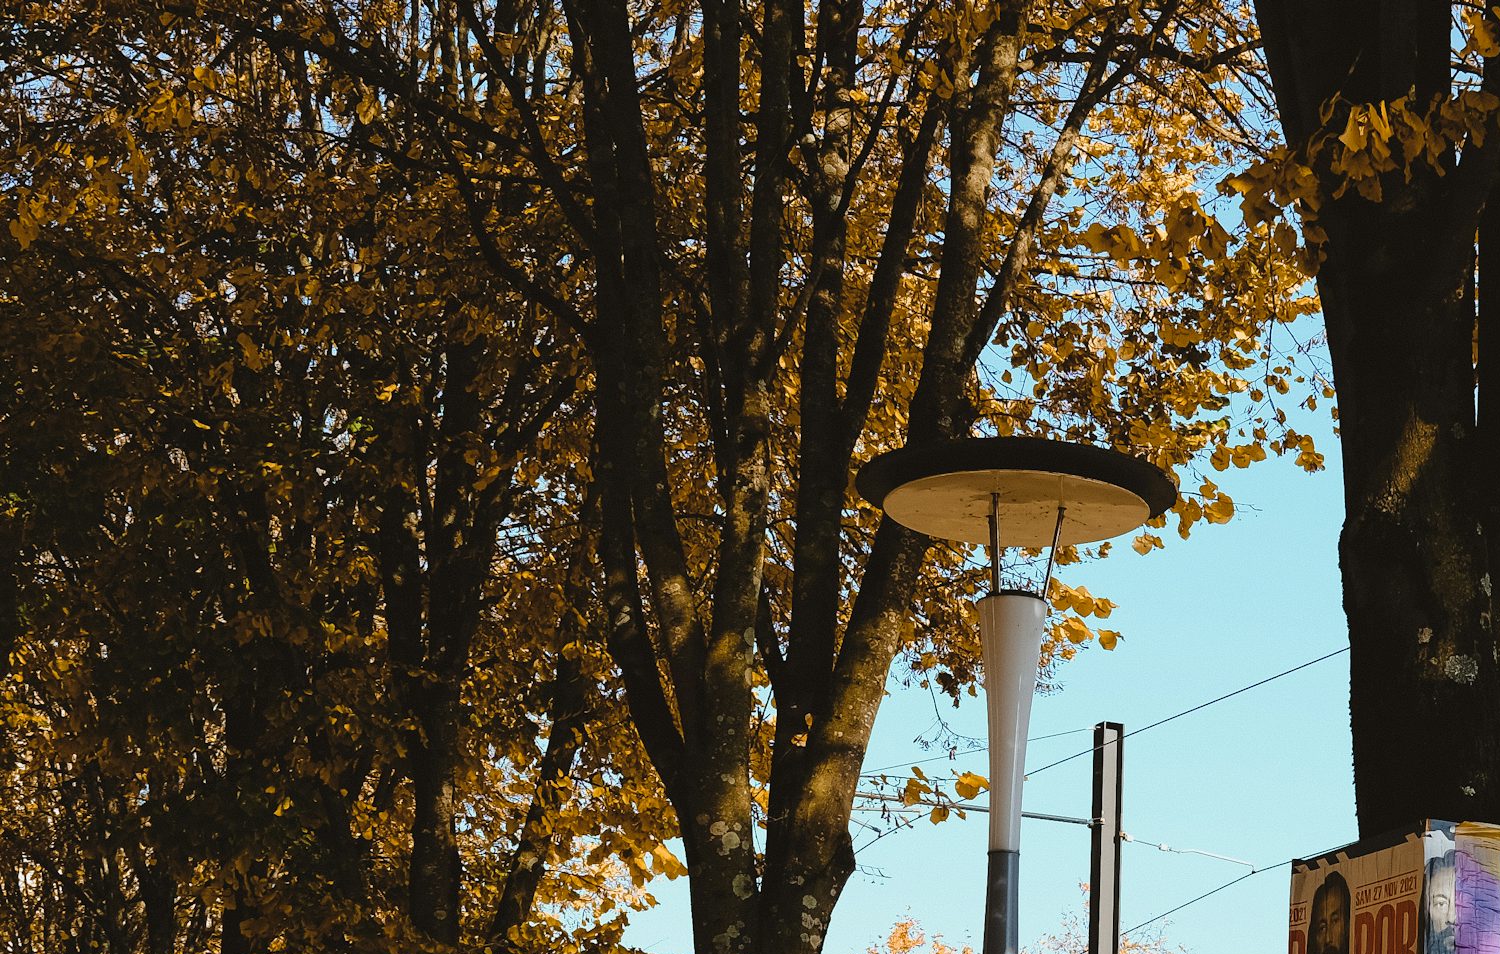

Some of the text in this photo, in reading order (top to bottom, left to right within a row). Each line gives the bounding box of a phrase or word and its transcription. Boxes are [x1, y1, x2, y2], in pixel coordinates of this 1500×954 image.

[1355, 875, 1418, 906] SAM 27 NOV 2021
